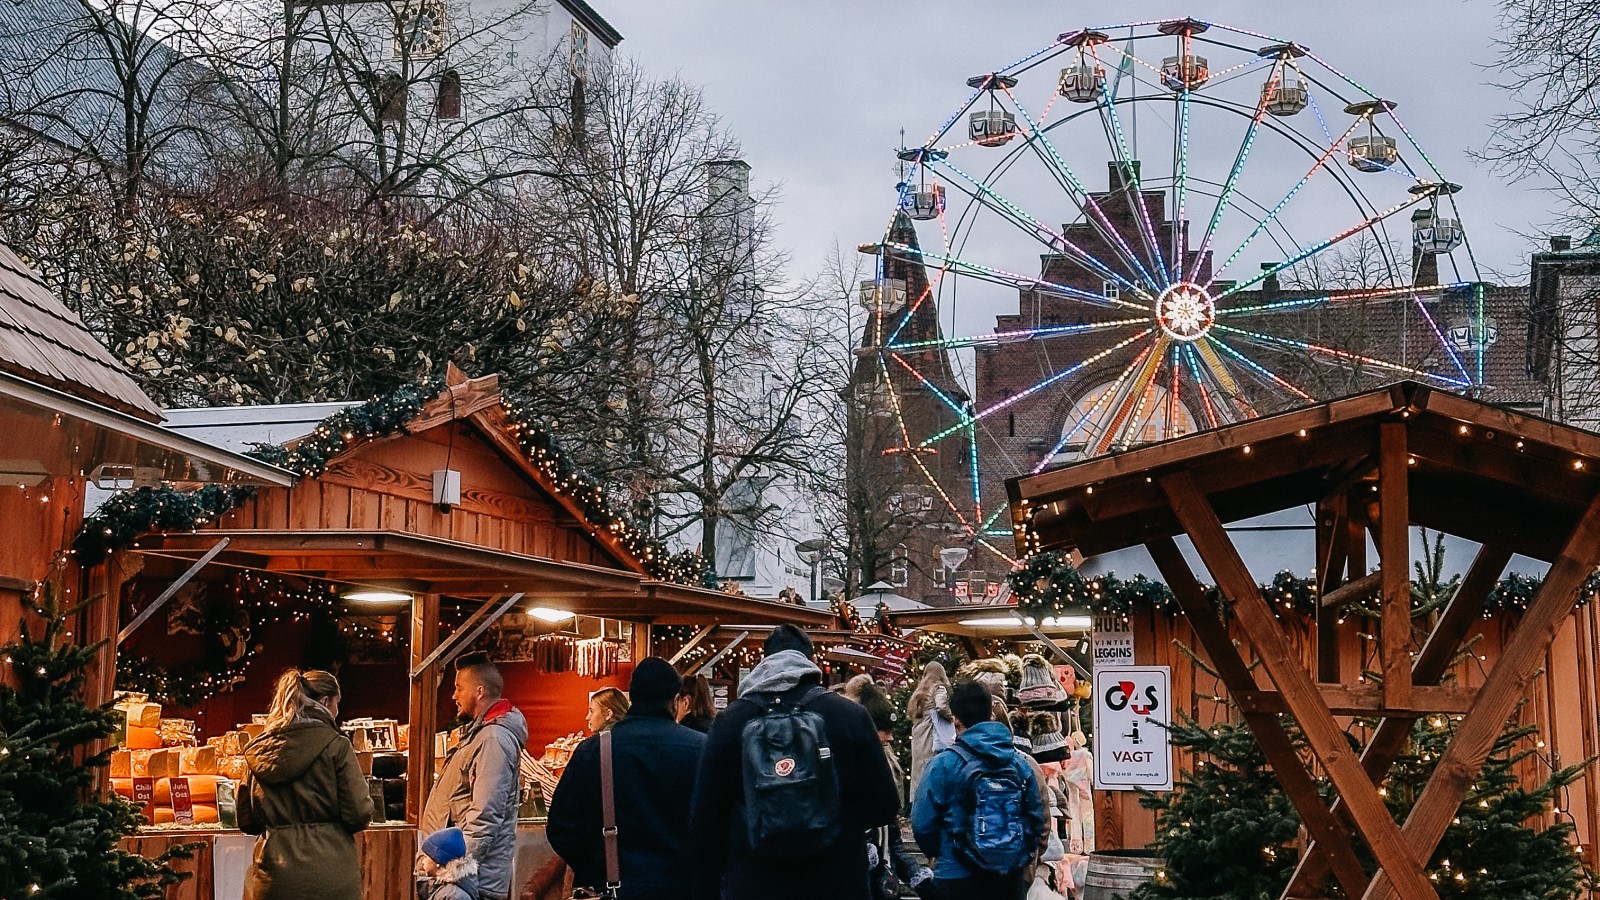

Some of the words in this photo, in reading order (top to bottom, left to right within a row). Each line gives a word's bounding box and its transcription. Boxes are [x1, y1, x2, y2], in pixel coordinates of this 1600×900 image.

[1094, 647, 1132, 658] LEGGINS
[1105, 681, 1159, 715] G4S
[1112, 751, 1154, 763] VAGT
